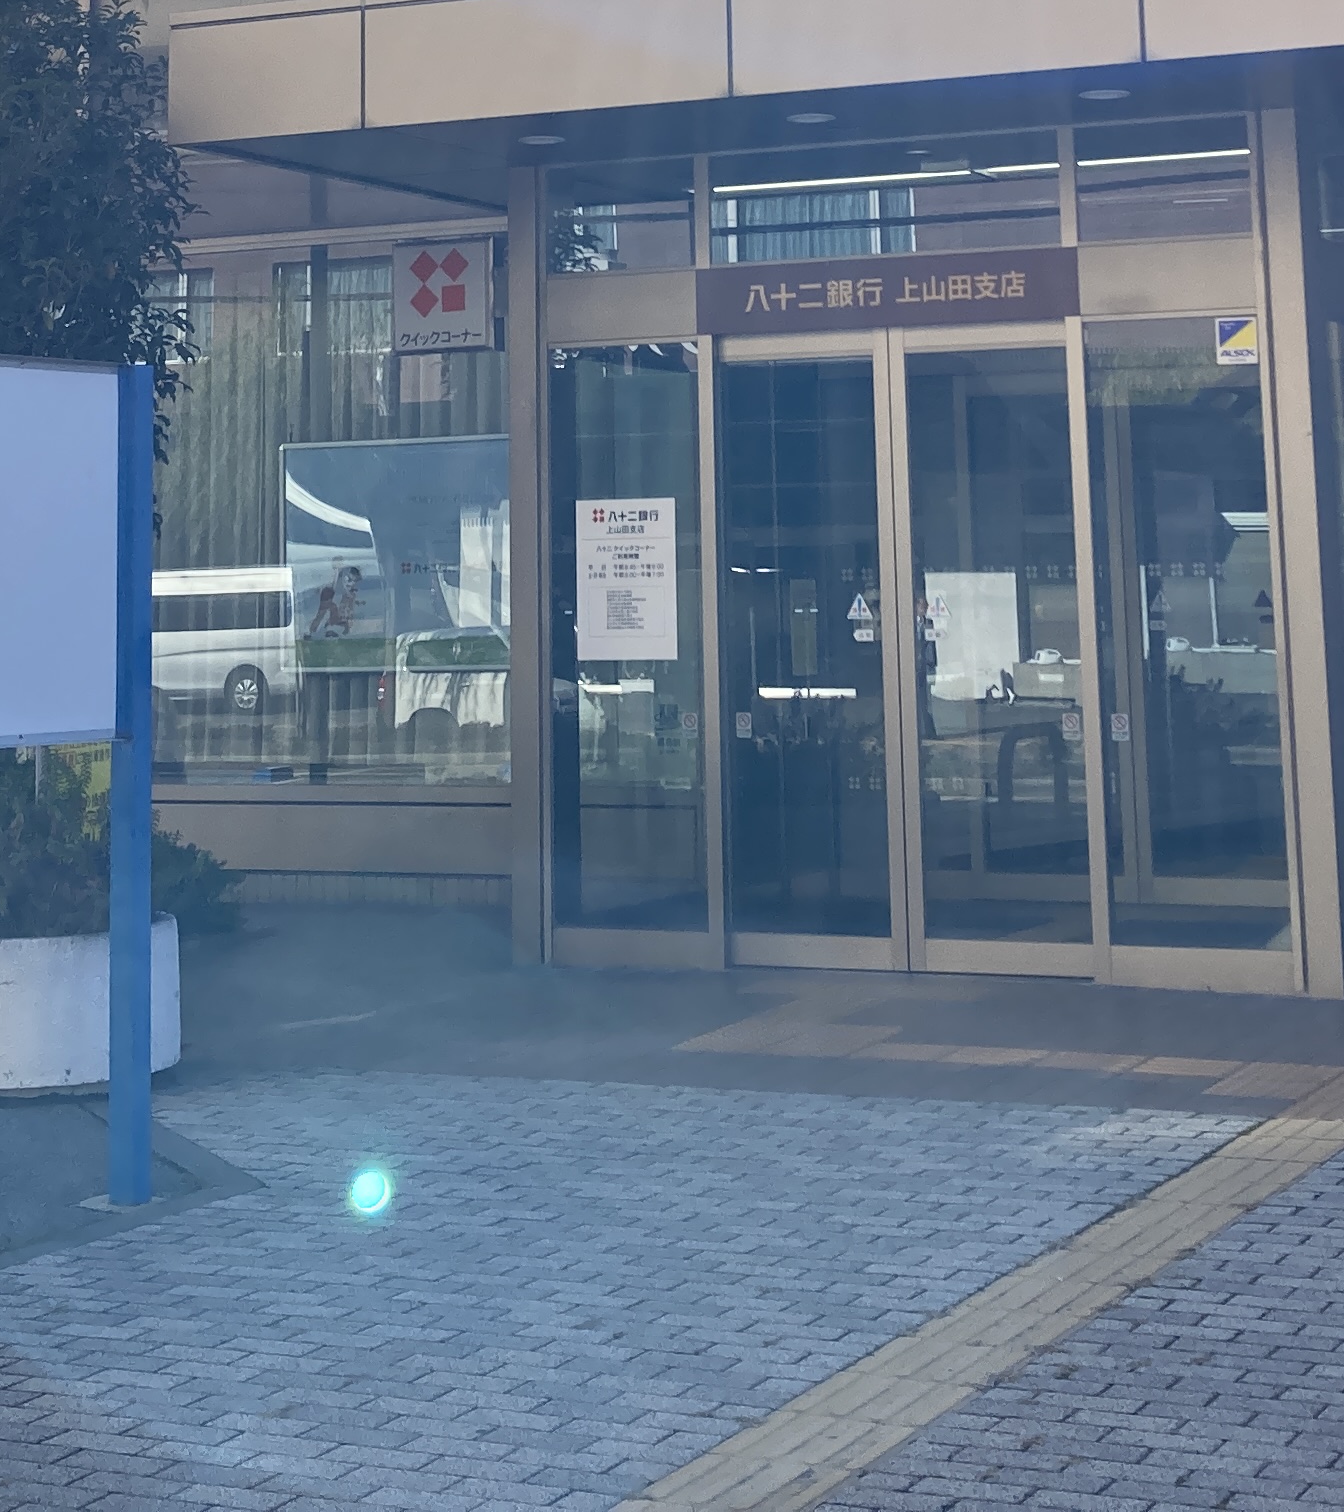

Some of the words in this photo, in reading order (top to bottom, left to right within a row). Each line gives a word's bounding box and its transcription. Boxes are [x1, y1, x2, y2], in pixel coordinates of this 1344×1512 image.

[745, 278, 883, 313] 八十二銀行
[896, 270, 1026, 303] 上山田支店
[400, 328, 482, 347] クイックコーナー
[608, 510, 659, 522] 八十二銀行
